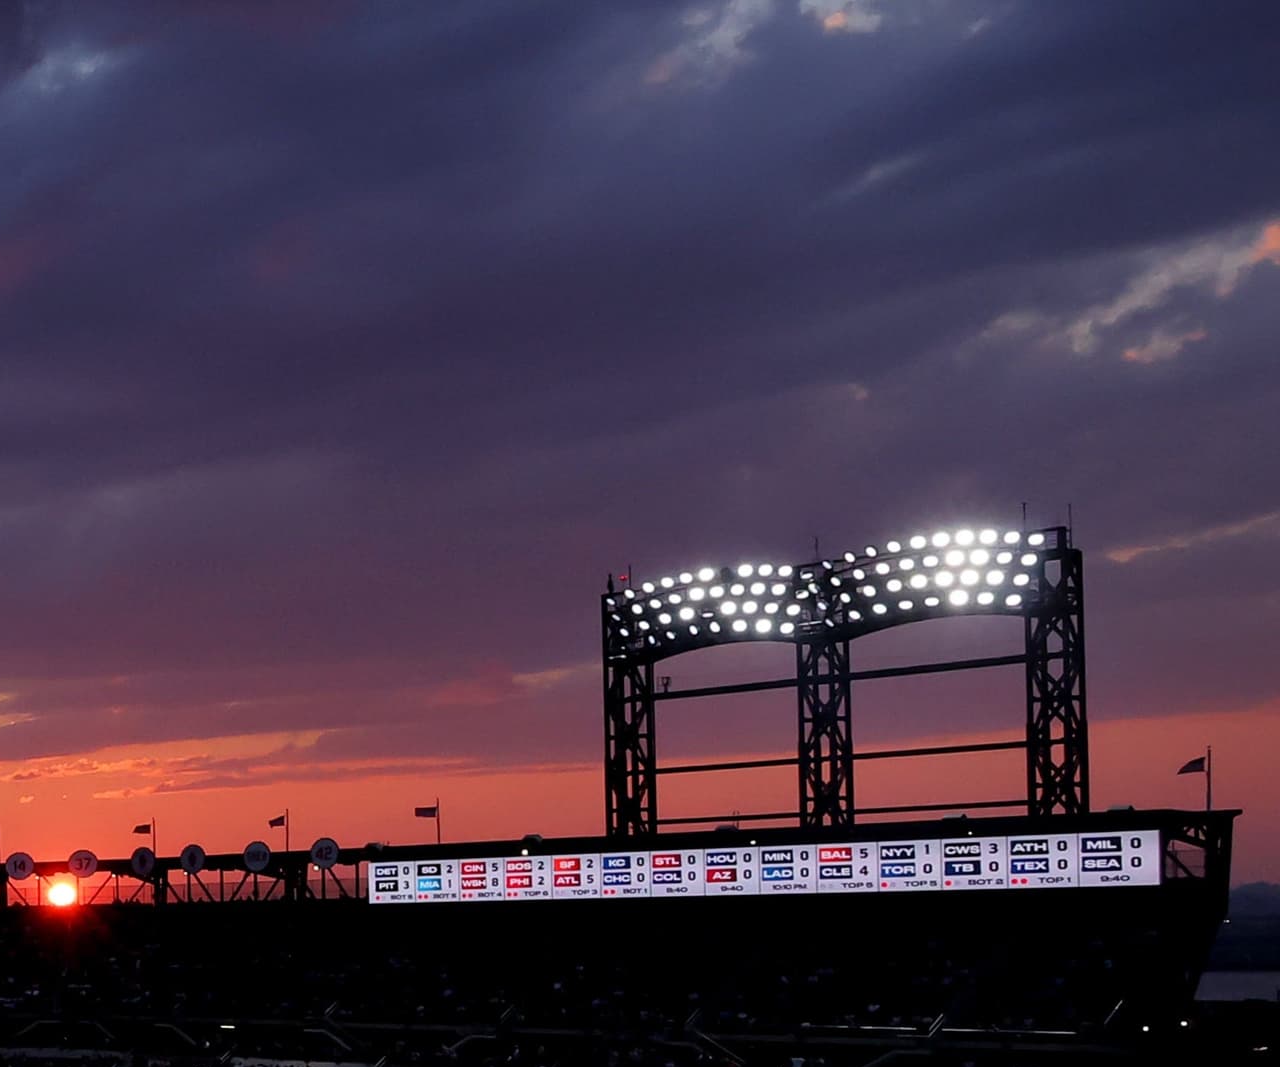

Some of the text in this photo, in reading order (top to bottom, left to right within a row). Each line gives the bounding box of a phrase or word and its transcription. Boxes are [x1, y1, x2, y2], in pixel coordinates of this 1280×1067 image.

[1012, 842, 1047, 853] ATH
[1086, 839, 1117, 849] MIL
[881, 848, 914, 858] NYY
[945, 844, 979, 854] CWS
[707, 854, 736, 864] HOU
[764, 852, 790, 862] MIN
[820, 850, 850, 860] BAL
[559, 860, 575, 869] SF
[608, 858, 625, 868] KC
[654, 857, 679, 866] STL
[1013, 861, 1047, 871] TEX
[1084, 858, 1120, 868] SEA
[421, 866, 438, 874] SD
[463, 864, 484, 873] CIN
[506, 862, 532, 871] BOS
[882, 865, 914, 875] TOR
[952, 863, 973, 873] TB
[376, 867, 397, 876] DET
[712, 870, 731, 880] AZ
[763, 868, 792, 878] LAD
[821, 867, 851, 876] CLE
[509, 877, 529, 886] PHI
[556, 876, 579, 885] ATL
[603, 874, 630, 883] CHC
[654, 873, 681, 882] COL
[378, 882, 396, 890] PIT
[419, 881, 440, 890] MIA
[462, 879, 486, 887] WSH
